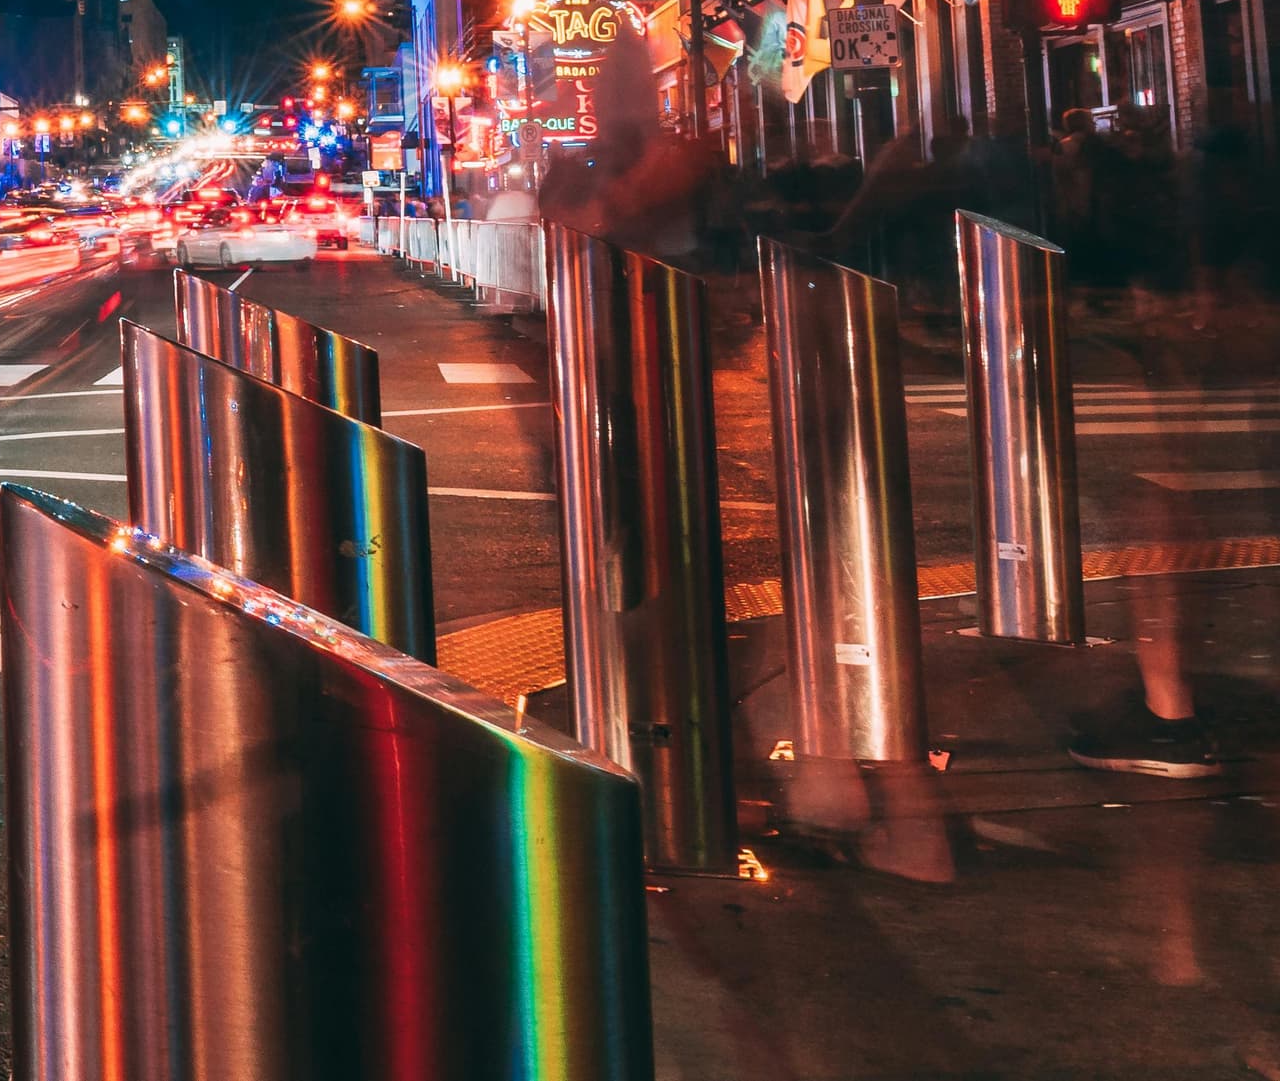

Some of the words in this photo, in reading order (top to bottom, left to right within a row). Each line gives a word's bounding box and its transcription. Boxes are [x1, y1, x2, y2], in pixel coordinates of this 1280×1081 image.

[836, 7, 890, 22] DIAGONAL
[837, 20, 890, 34] CROSSING
[833, 39, 861, 61] OK
